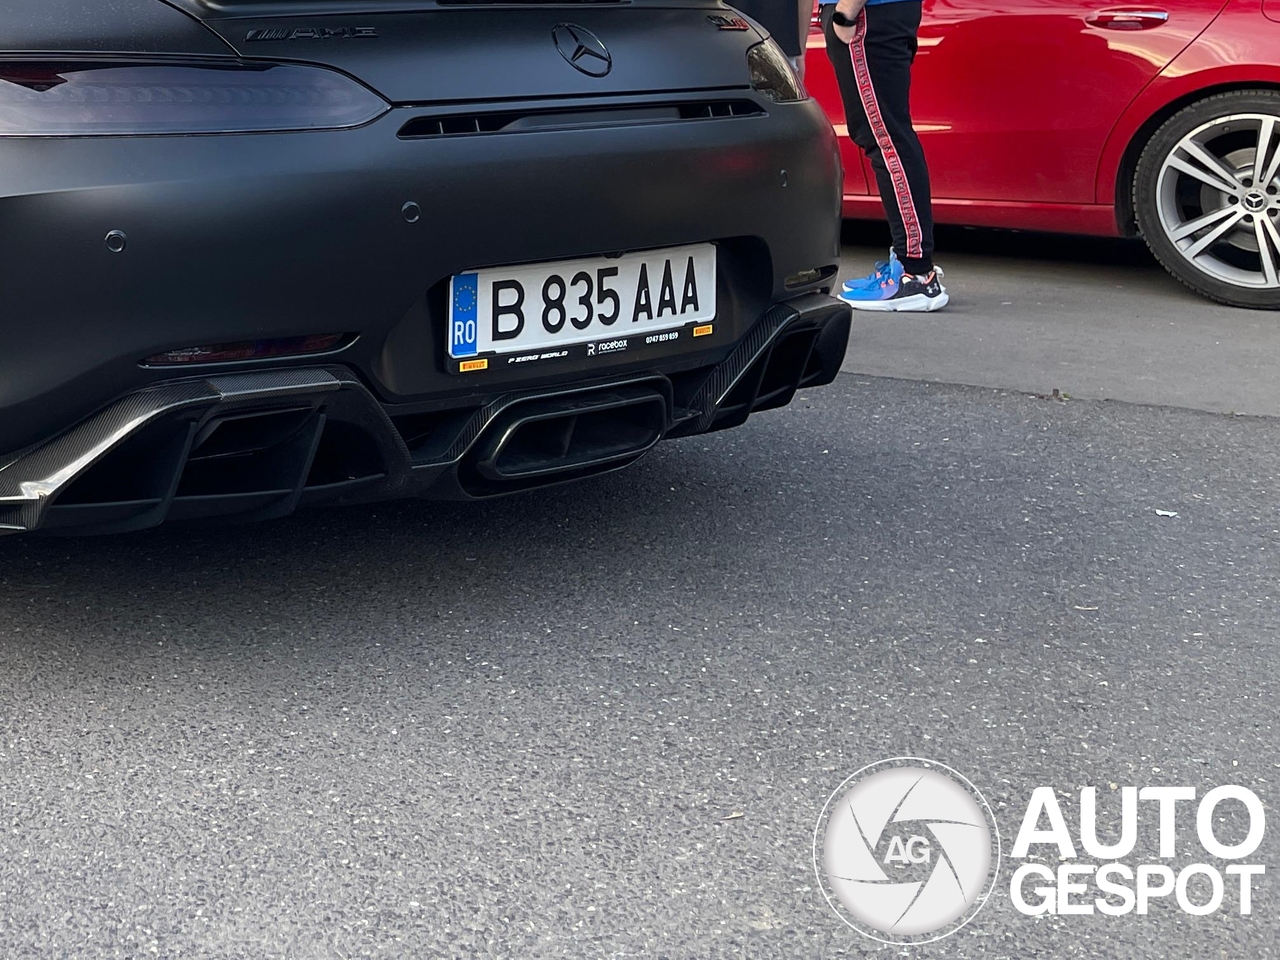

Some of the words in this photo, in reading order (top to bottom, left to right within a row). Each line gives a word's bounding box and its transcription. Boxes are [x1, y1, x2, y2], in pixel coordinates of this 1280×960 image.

[863, 87, 881, 127] CHICAGO
[492, 279, 525, 342] B
[541, 266, 620, 334] 835
[632, 256, 700, 323] AAA
[454, 320, 476, 346] RO
[598, 339, 628, 351] racebox
[514, 354, 540, 363] ZERO
[540, 350, 569, 360] WORLD
